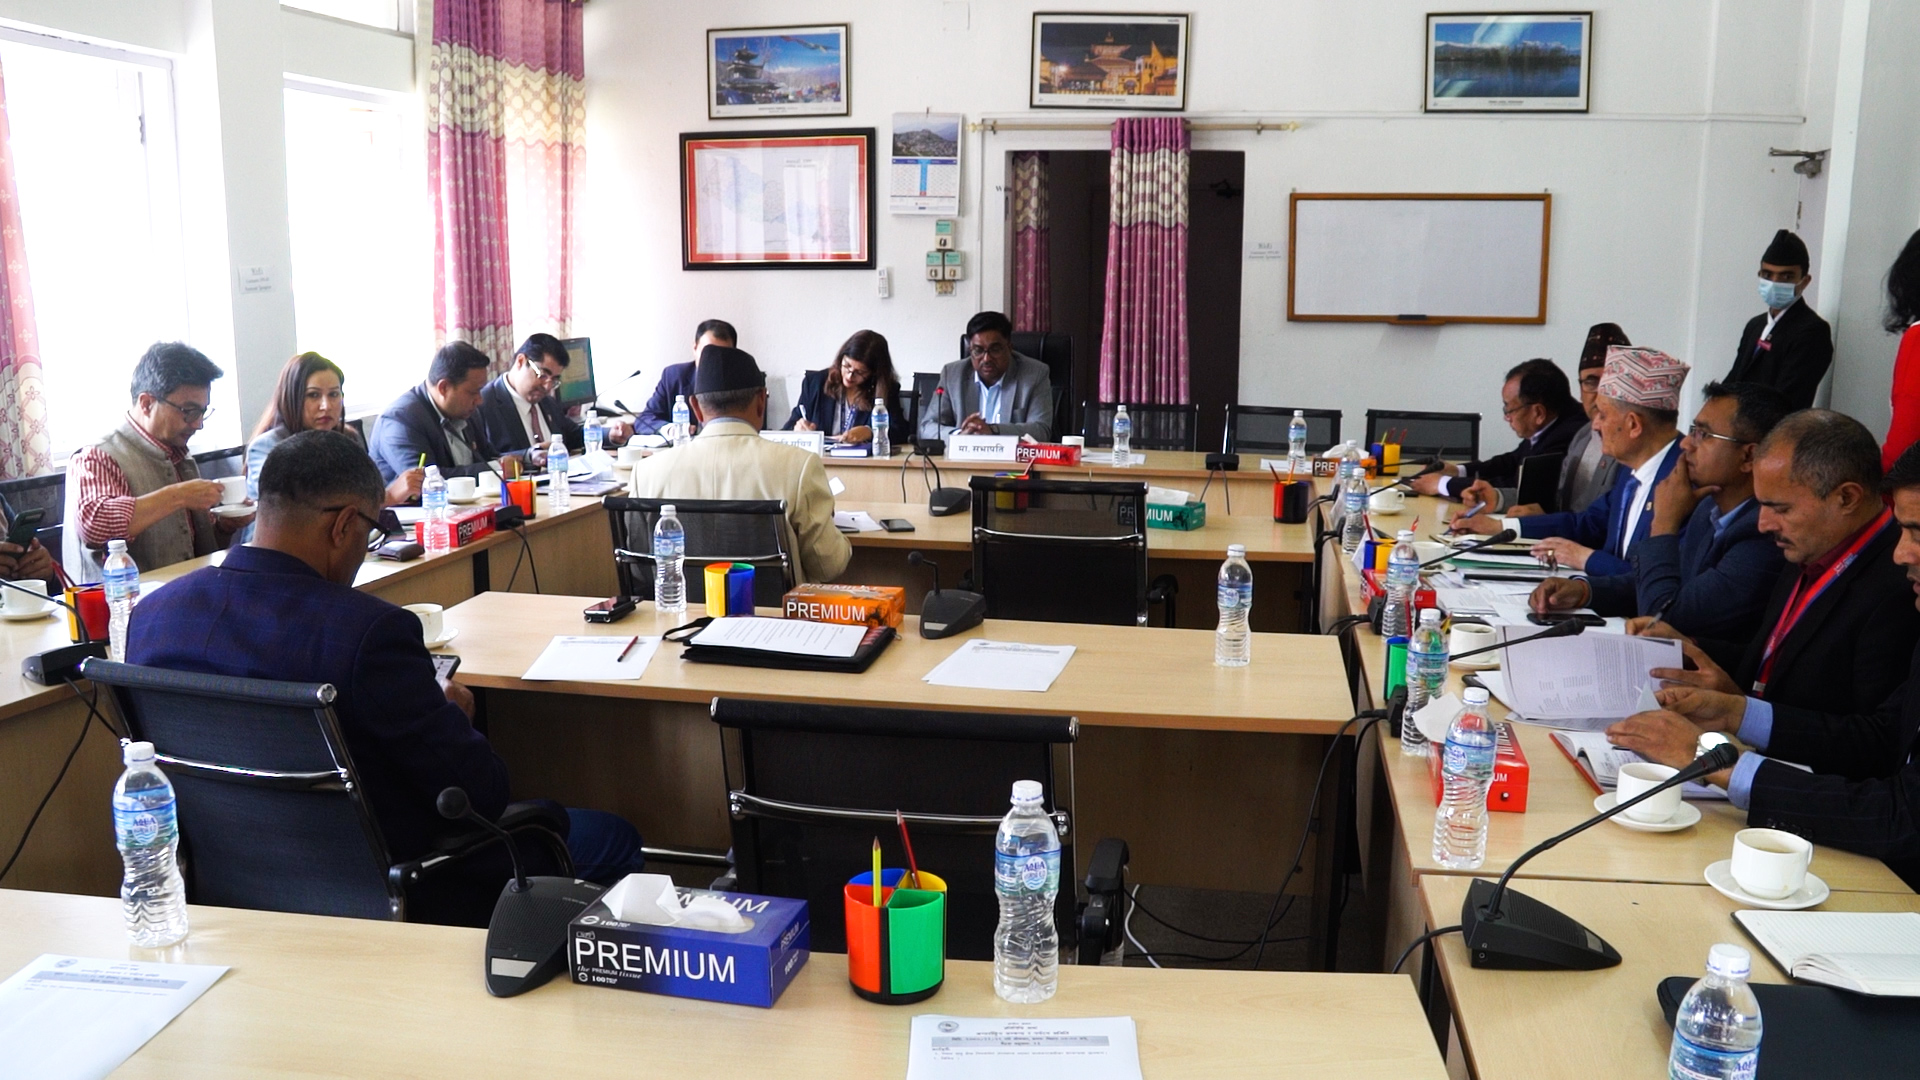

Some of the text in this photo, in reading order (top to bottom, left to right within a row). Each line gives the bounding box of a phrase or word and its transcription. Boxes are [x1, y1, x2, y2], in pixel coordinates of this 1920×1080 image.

[958, 443, 1005, 453] मा. सभापति
[1016, 447, 1061, 460] PREMIUM
[458, 516, 488, 539] PREMIUM
[786, 601, 865, 622] PREMIUM
[1024, 861, 1046, 872] AQUA
[575, 938, 736, 984] PREMIUM
[591, 967, 618, 976] PREMIUM
[619, 971, 642, 979] tissue
